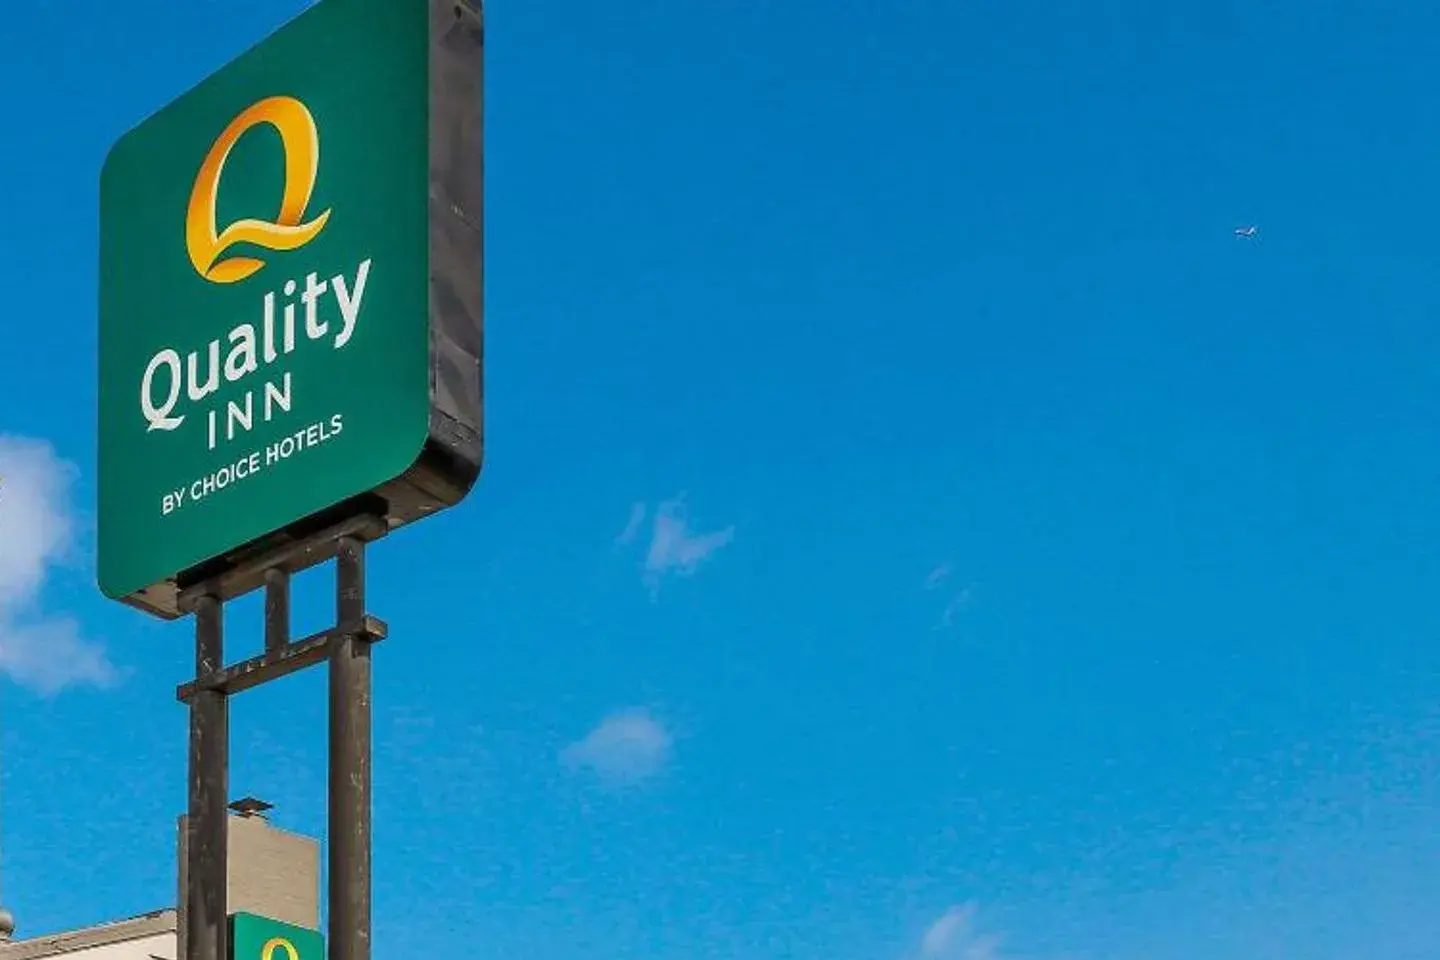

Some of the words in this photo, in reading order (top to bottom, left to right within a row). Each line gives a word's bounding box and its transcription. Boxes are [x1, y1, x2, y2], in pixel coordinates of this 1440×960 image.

[186, 95, 332, 284] Q
[140, 258, 372, 433] Quality
[207, 372, 292, 450] INN
[161, 487, 186, 516] BY
[190, 451, 261, 501] CHOICE
[265, 413, 344, 466] HOTELS
